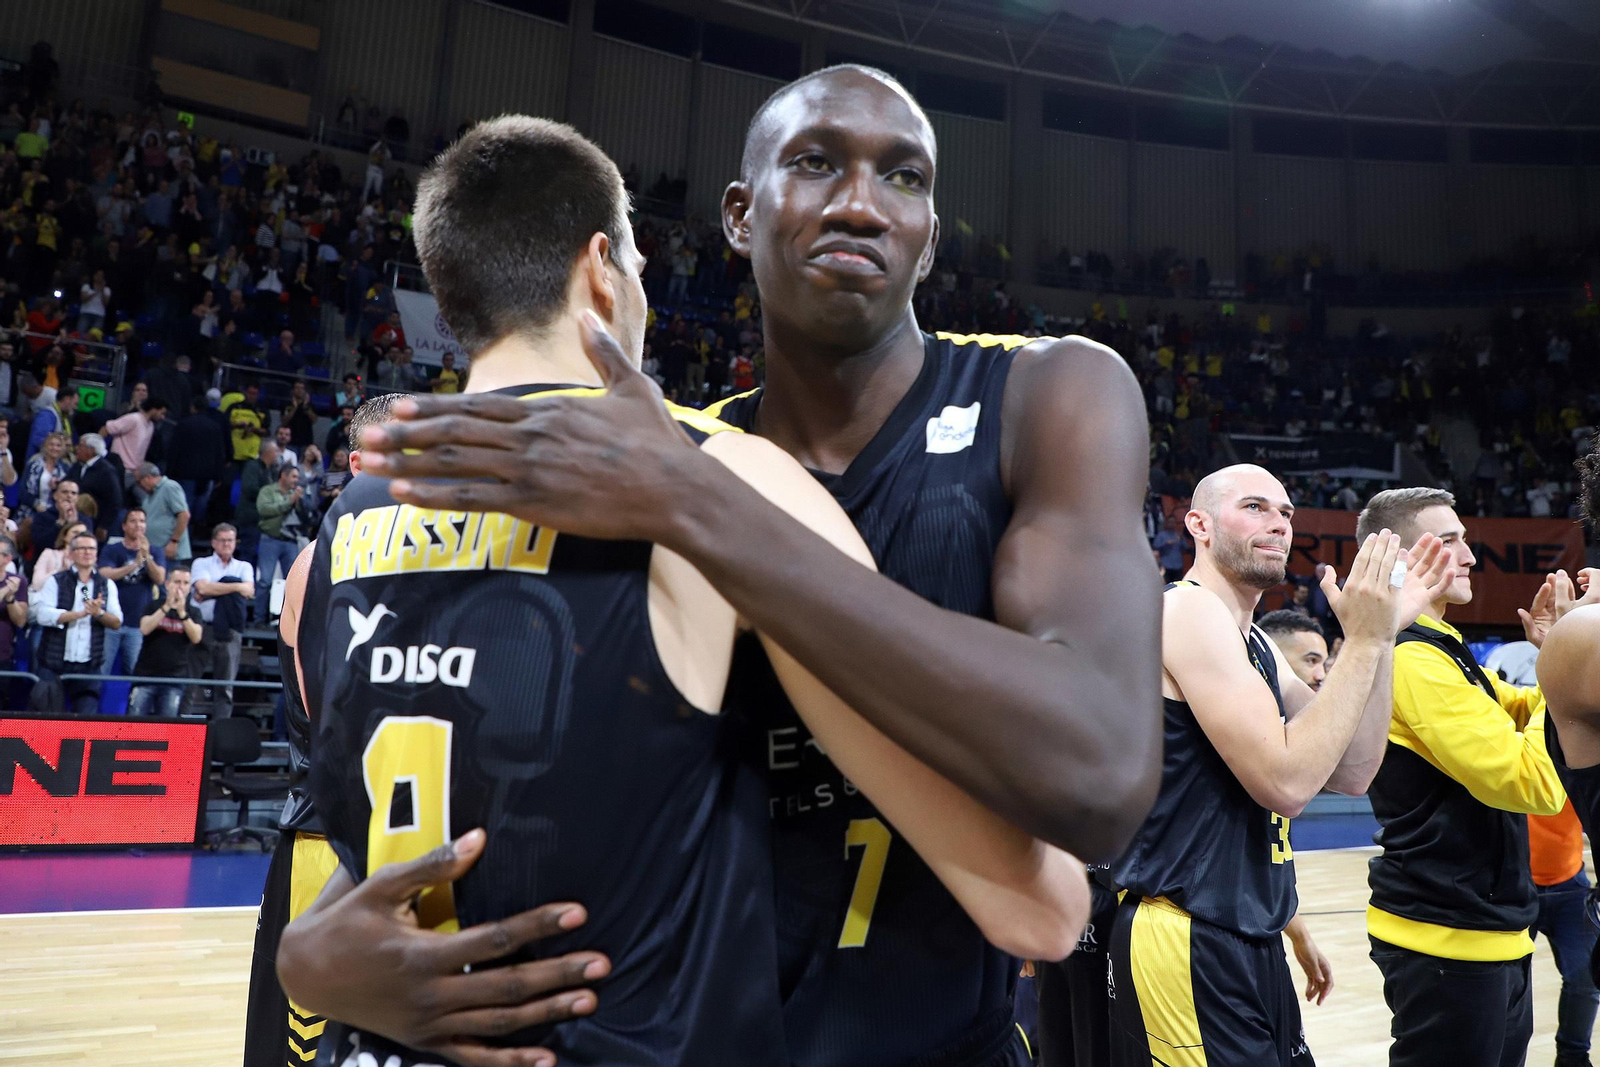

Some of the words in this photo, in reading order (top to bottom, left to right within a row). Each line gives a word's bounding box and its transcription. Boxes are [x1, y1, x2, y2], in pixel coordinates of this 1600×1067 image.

[416, 338, 429, 350] LA
[84, 392, 99, 408] C
[331, 504, 558, 586] BRUSSINO
[0, 737, 170, 797] NE
[837, 816, 893, 949] 7
